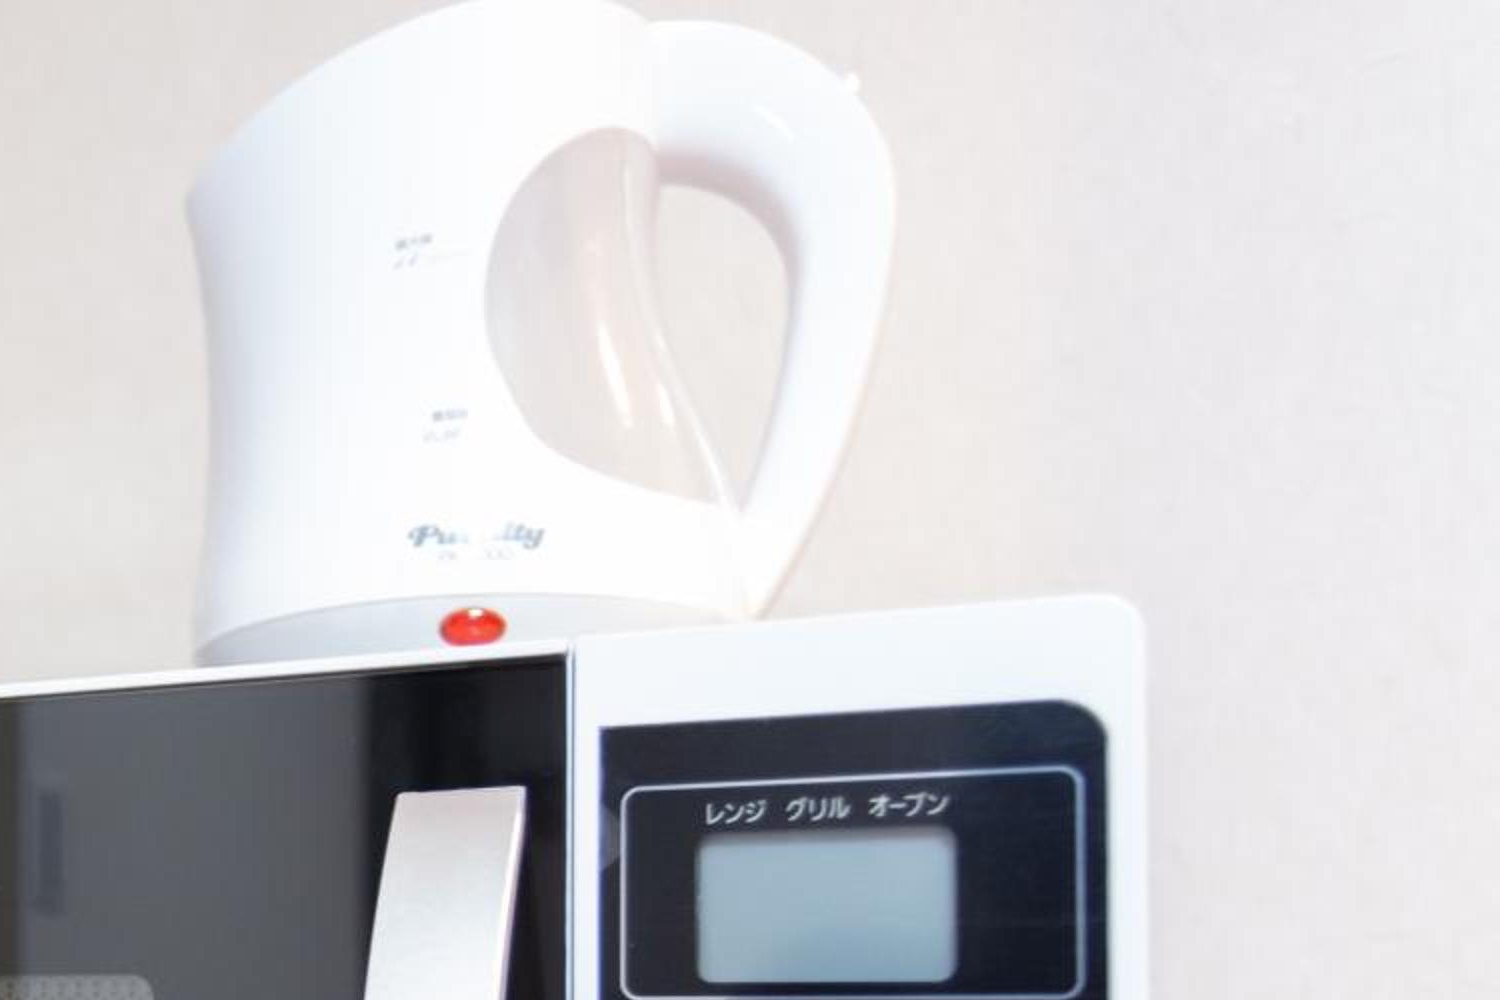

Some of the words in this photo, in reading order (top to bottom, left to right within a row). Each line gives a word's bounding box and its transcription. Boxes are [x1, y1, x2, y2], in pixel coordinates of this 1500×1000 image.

[705, 800, 767, 825] レンジ
[786, 796, 851, 822] グリル
[868, 791, 950, 817] オープン
